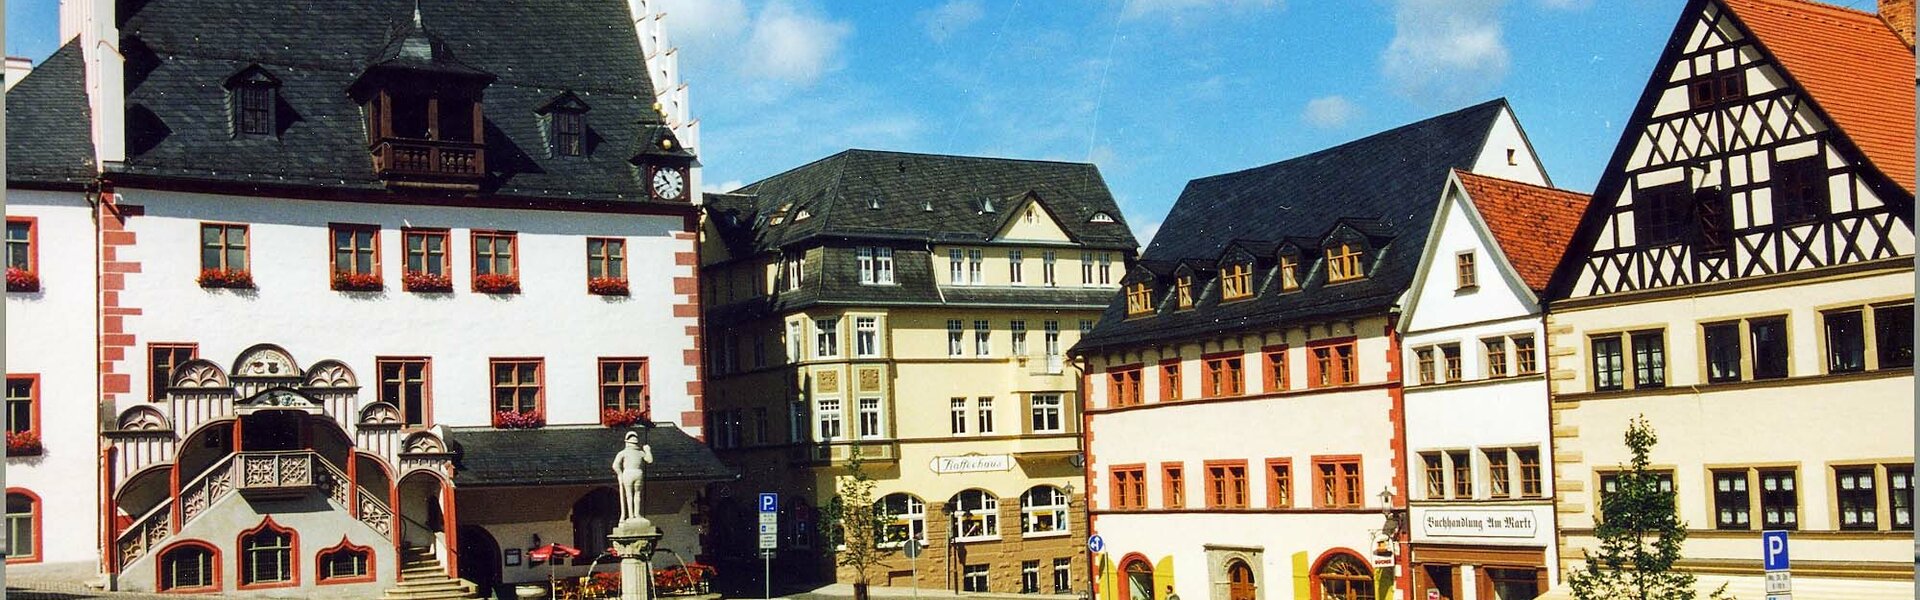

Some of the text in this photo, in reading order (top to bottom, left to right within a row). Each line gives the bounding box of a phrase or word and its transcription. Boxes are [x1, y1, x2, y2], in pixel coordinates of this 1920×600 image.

[943, 459, 1002, 471] Kaffeehaus
[763, 496, 773, 510] P
[1427, 516, 1531, 531] Buchhandlung Am Markt
[1768, 535, 1783, 566] P
